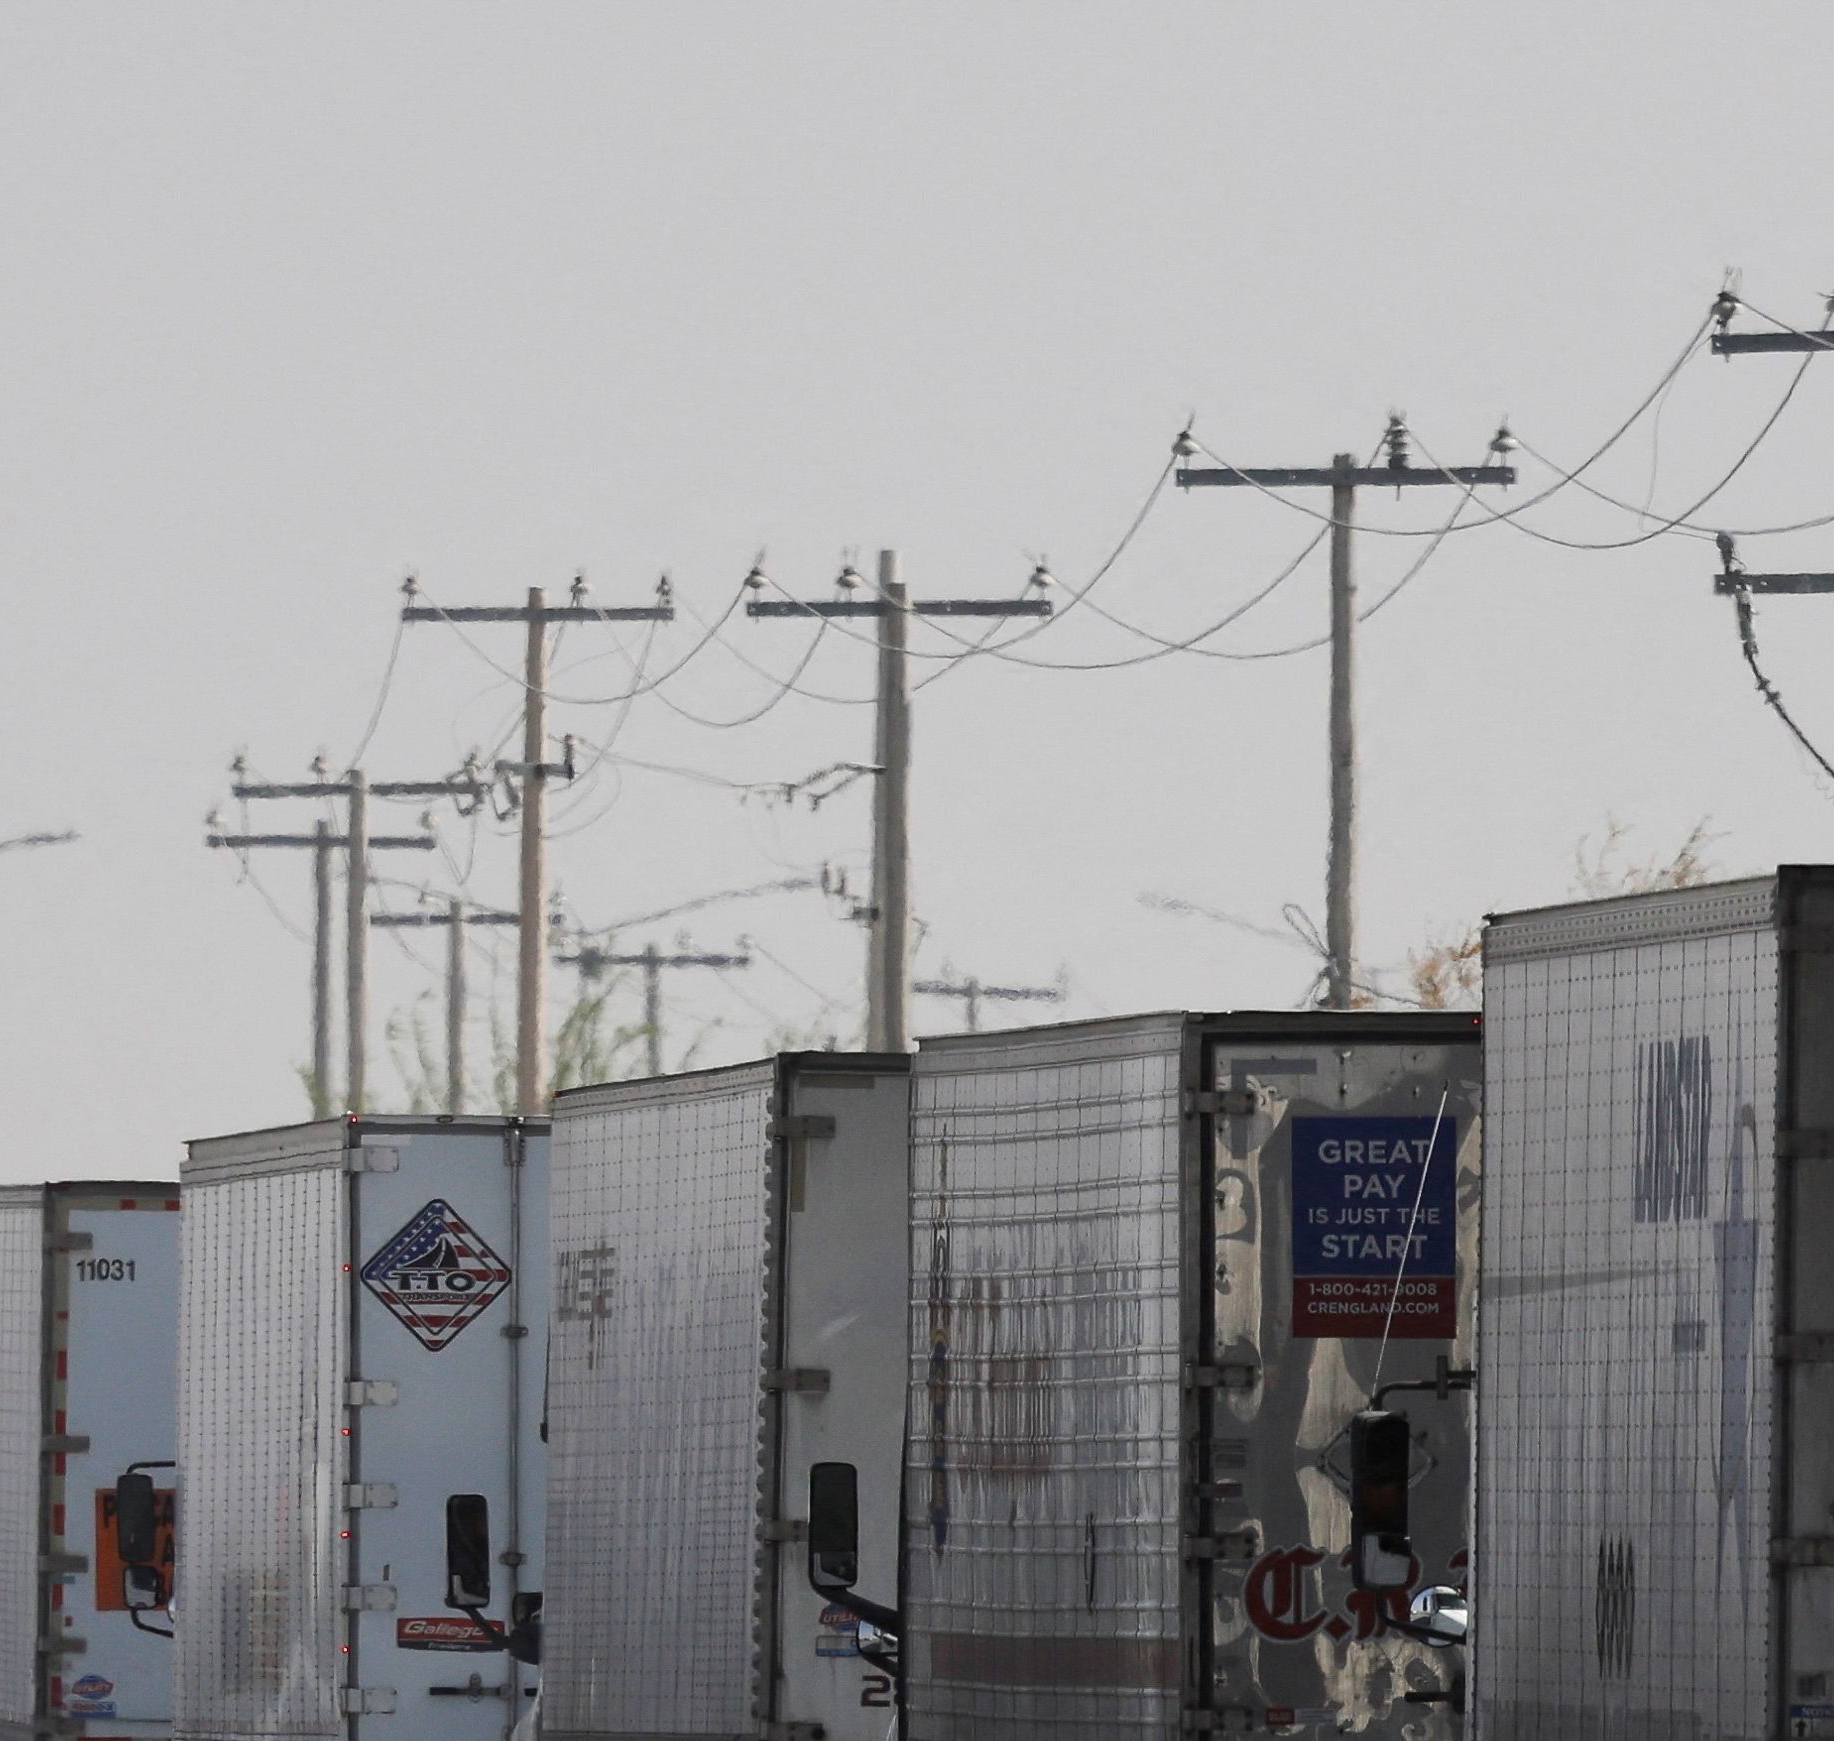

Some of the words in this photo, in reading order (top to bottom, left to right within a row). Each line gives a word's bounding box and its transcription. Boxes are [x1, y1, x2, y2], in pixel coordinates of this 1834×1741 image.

[1318, 1139, 1432, 1165] GREAT
[1344, 1173, 1407, 1200] PAY
[1308, 1208, 1330, 1225] IS
[1334, 1208, 1390, 1225] JUST
[1396, 1208, 1441, 1225] THE
[1321, 1234, 1429, 1260] START
[77, 1258, 137, 1281] 11031
[1307, 1302, 1440, 1314] CRENGLAND.COM
